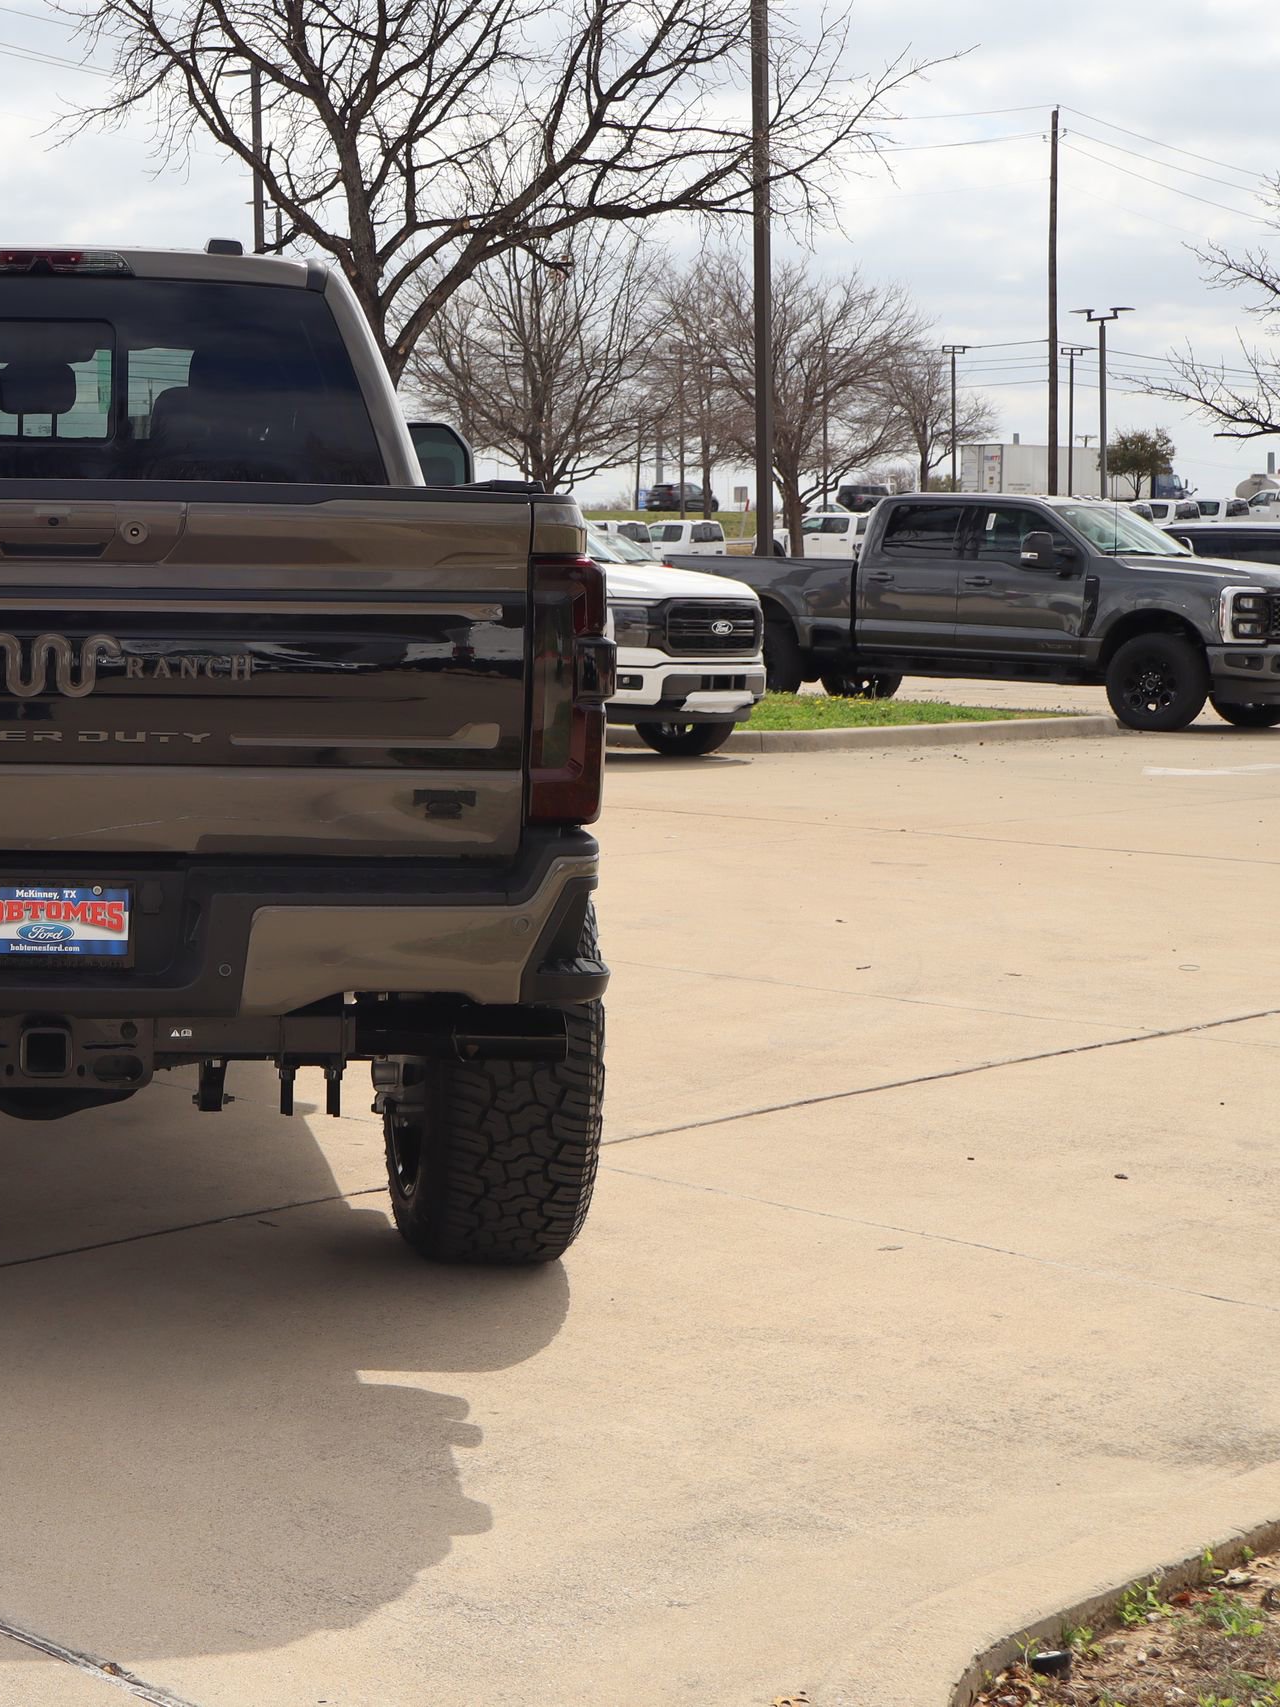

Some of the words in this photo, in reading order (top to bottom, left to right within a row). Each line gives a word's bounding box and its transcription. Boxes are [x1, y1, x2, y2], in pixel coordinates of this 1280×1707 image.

[125, 654, 252, 680] RANCH
[78, 730, 211, 743] DUTY
[15, 889, 59, 899] McKinney,
[63, 890, 77, 899] TX
[28, 923, 63, 940] Ford
[10, 943, 80, 952] bobtomesford.com
